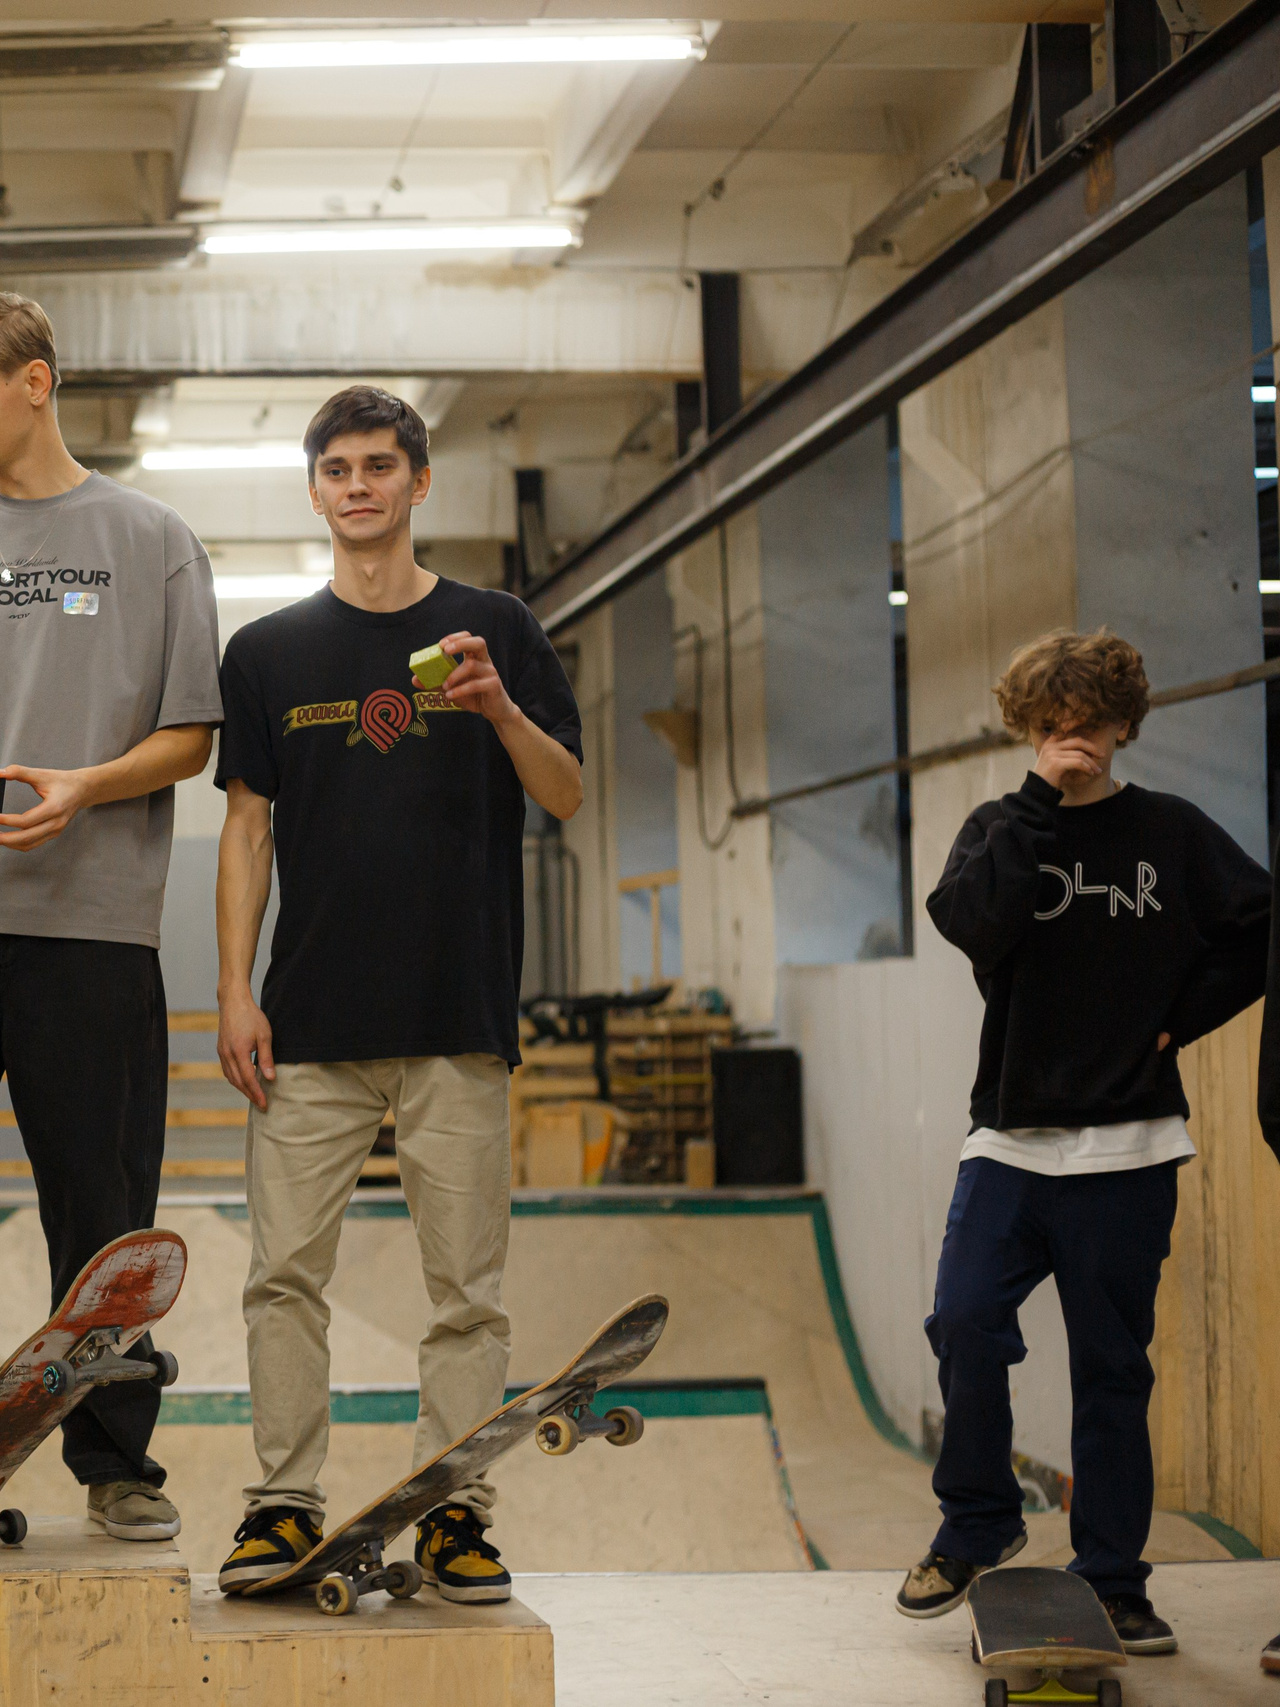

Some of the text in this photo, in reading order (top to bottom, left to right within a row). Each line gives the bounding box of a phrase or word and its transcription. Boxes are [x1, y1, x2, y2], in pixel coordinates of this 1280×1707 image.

[46, 568, 111, 587] YOUR
[297, 702, 355, 724] POWELL
[1034, 861, 1162, 920] OLAR
